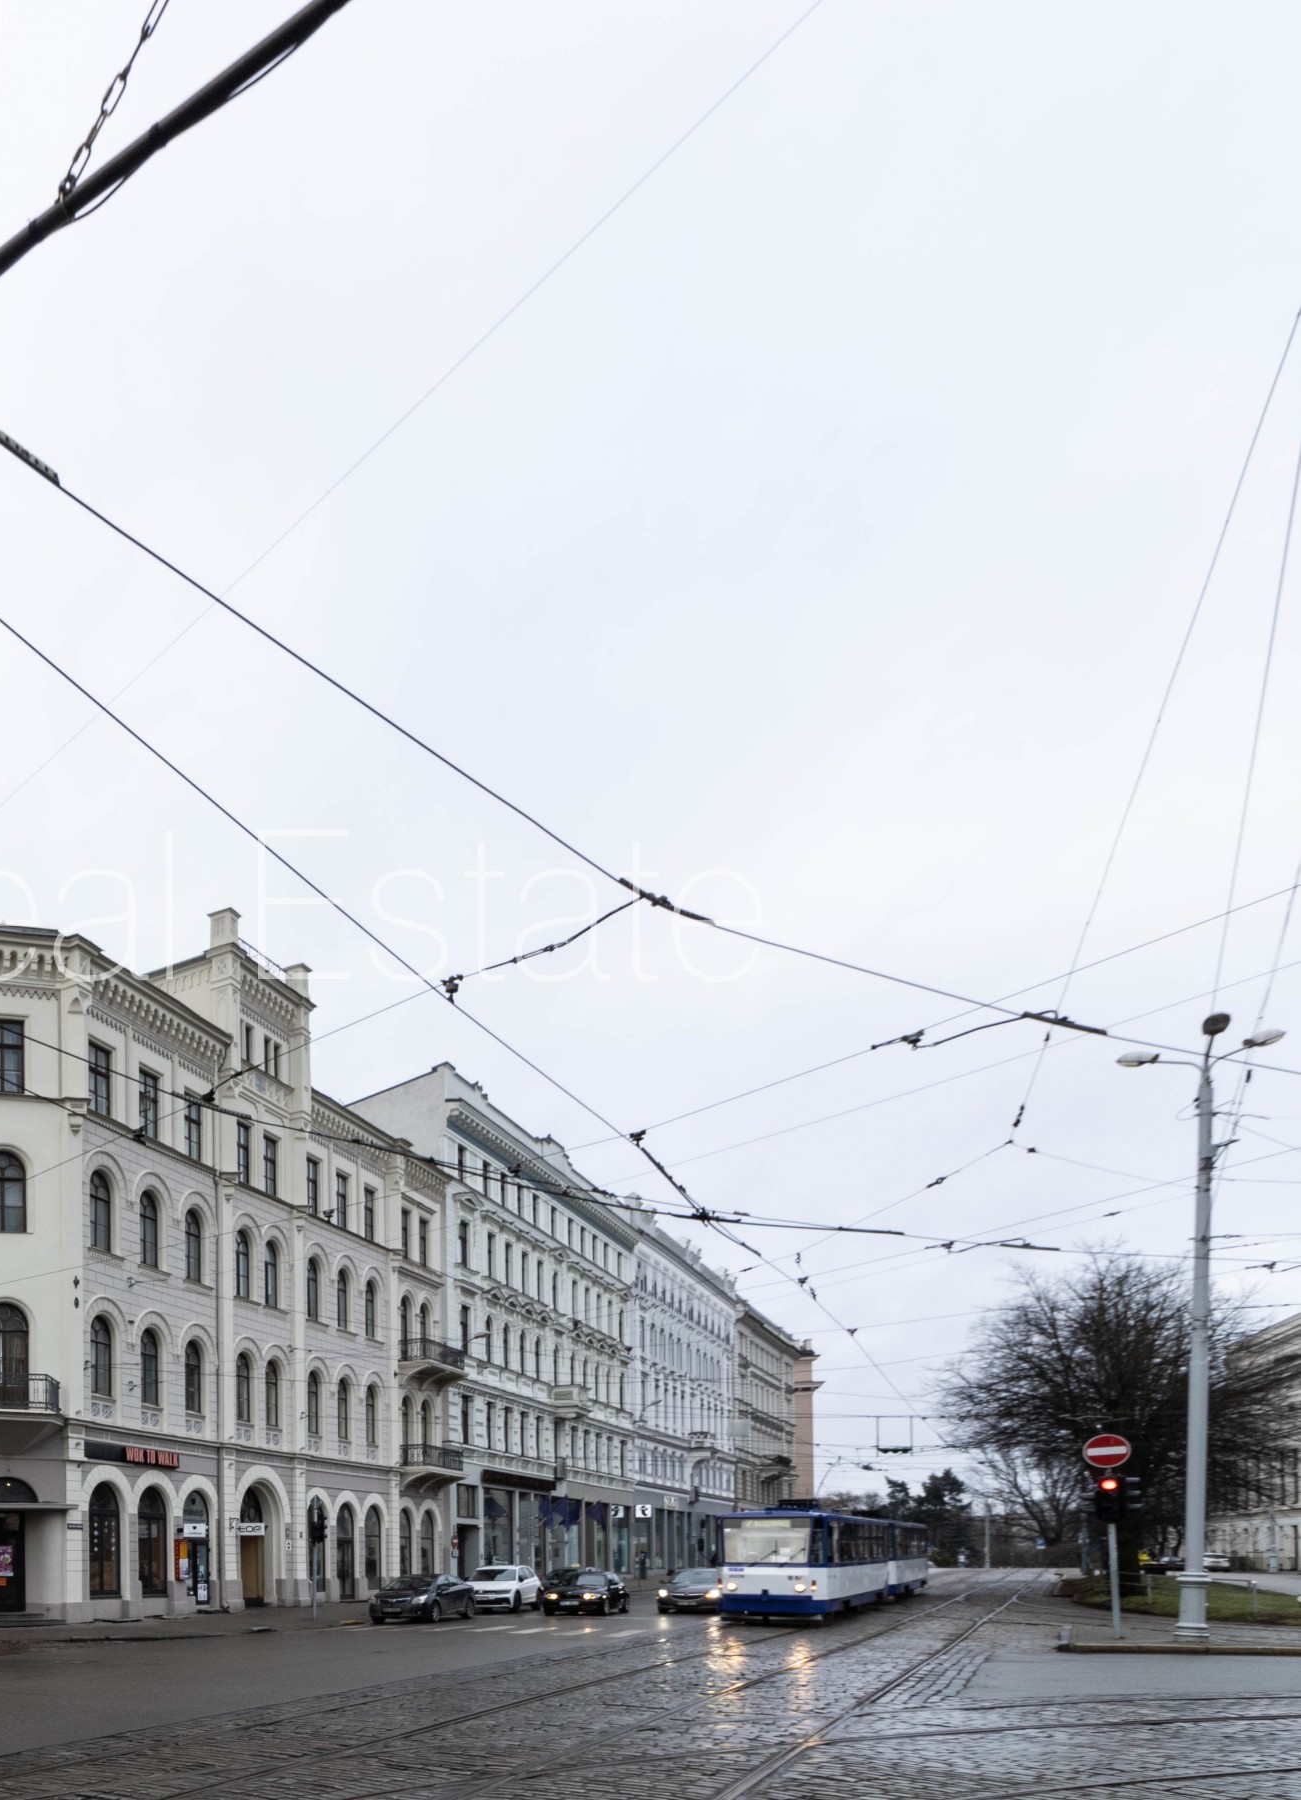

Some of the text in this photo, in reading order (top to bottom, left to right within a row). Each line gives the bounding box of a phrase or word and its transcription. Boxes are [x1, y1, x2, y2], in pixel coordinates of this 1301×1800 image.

[125, 1446, 179, 1467] WOK TO WALK
